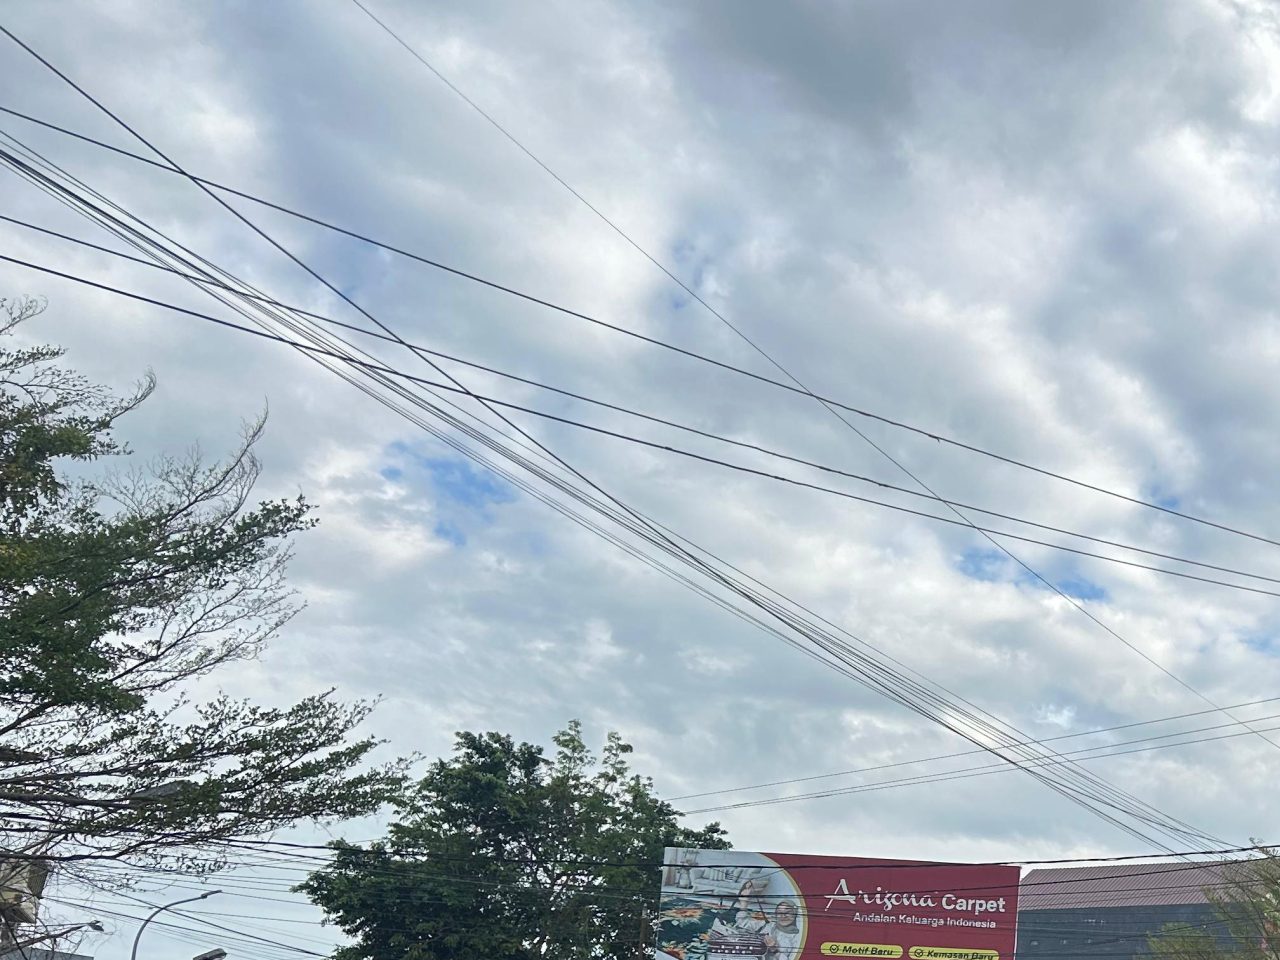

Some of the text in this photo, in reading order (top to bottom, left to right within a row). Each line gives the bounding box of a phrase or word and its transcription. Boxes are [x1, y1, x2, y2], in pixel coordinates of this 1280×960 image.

[942, 893, 1006, 915] Carpet
[853, 912, 997, 929] Andalan Keluarga Indonesia
[842, 945, 894, 956] Motif Baru
[926, 949, 994, 960] Kemasan Baru
